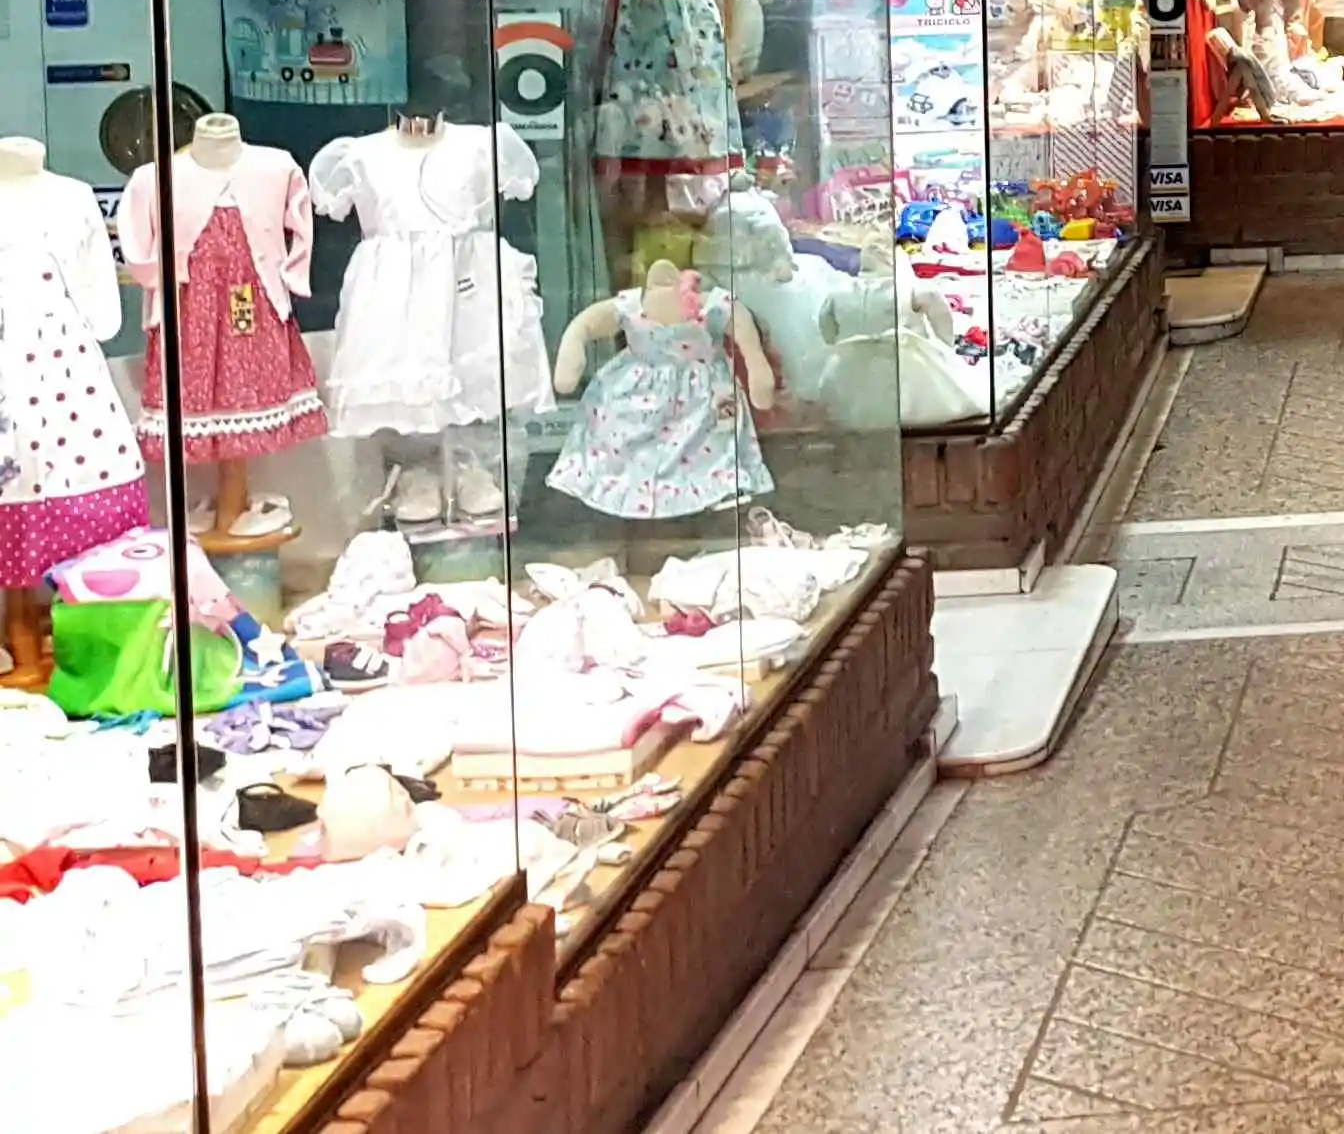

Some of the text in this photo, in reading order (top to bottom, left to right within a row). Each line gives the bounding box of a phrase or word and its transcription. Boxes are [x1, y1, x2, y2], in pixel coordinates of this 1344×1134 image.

[917, 18, 971, 27] TRICICLO
[1151, 171, 1184, 185] VISA
[1151, 199, 1183, 213] VISA
